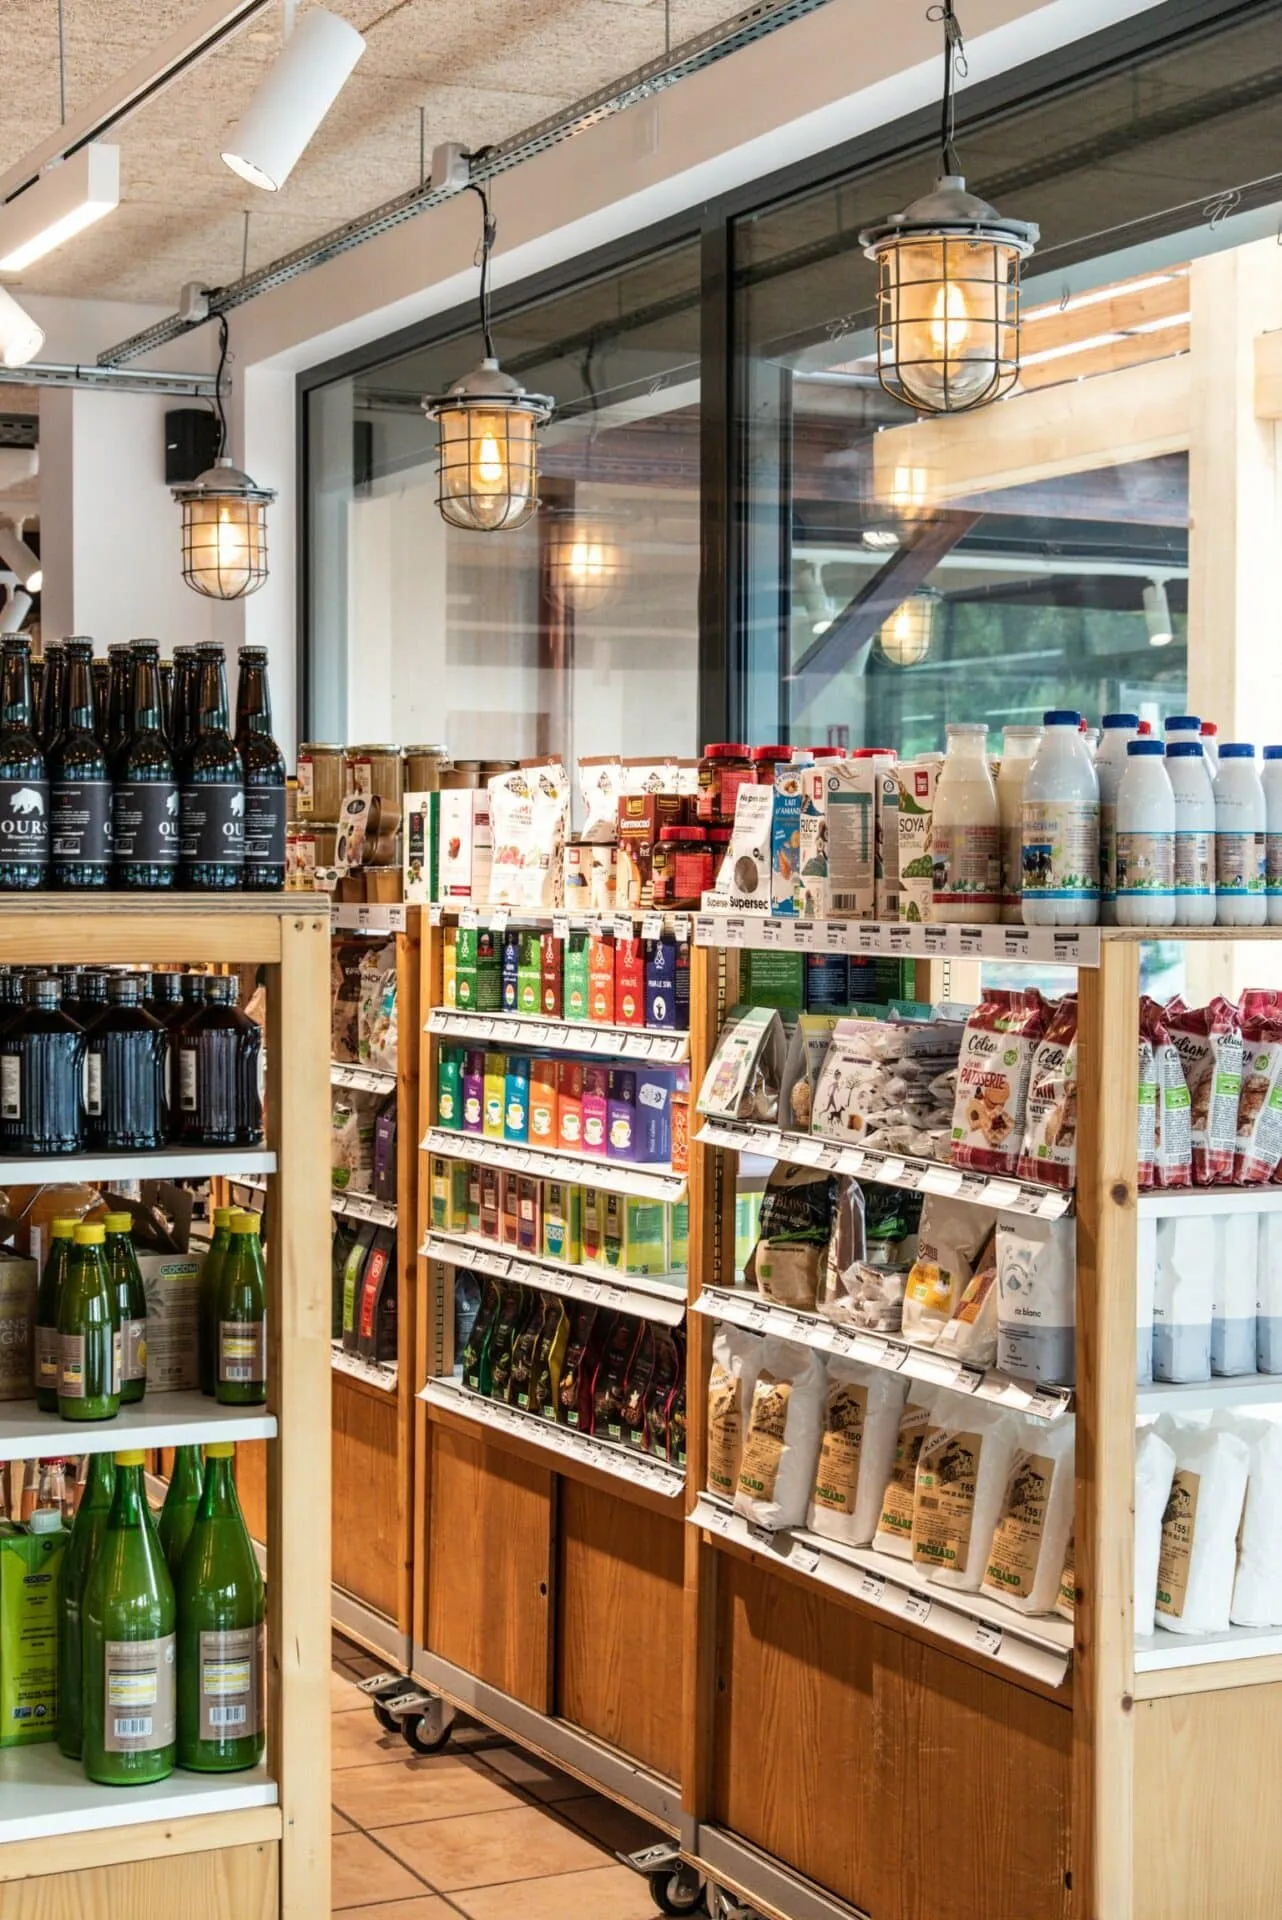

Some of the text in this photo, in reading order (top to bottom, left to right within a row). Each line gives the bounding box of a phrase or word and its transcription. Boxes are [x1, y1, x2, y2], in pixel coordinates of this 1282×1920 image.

[1, 819, 49, 835] OURS
[801, 818, 818, 832] RICE
[899, 817, 925, 832] SOYA
[960, 1068, 1007, 1090] PATISSERIE
[1022, 1307, 1042, 1318] blanc
[916, 1541, 956, 1560] PICHARD
